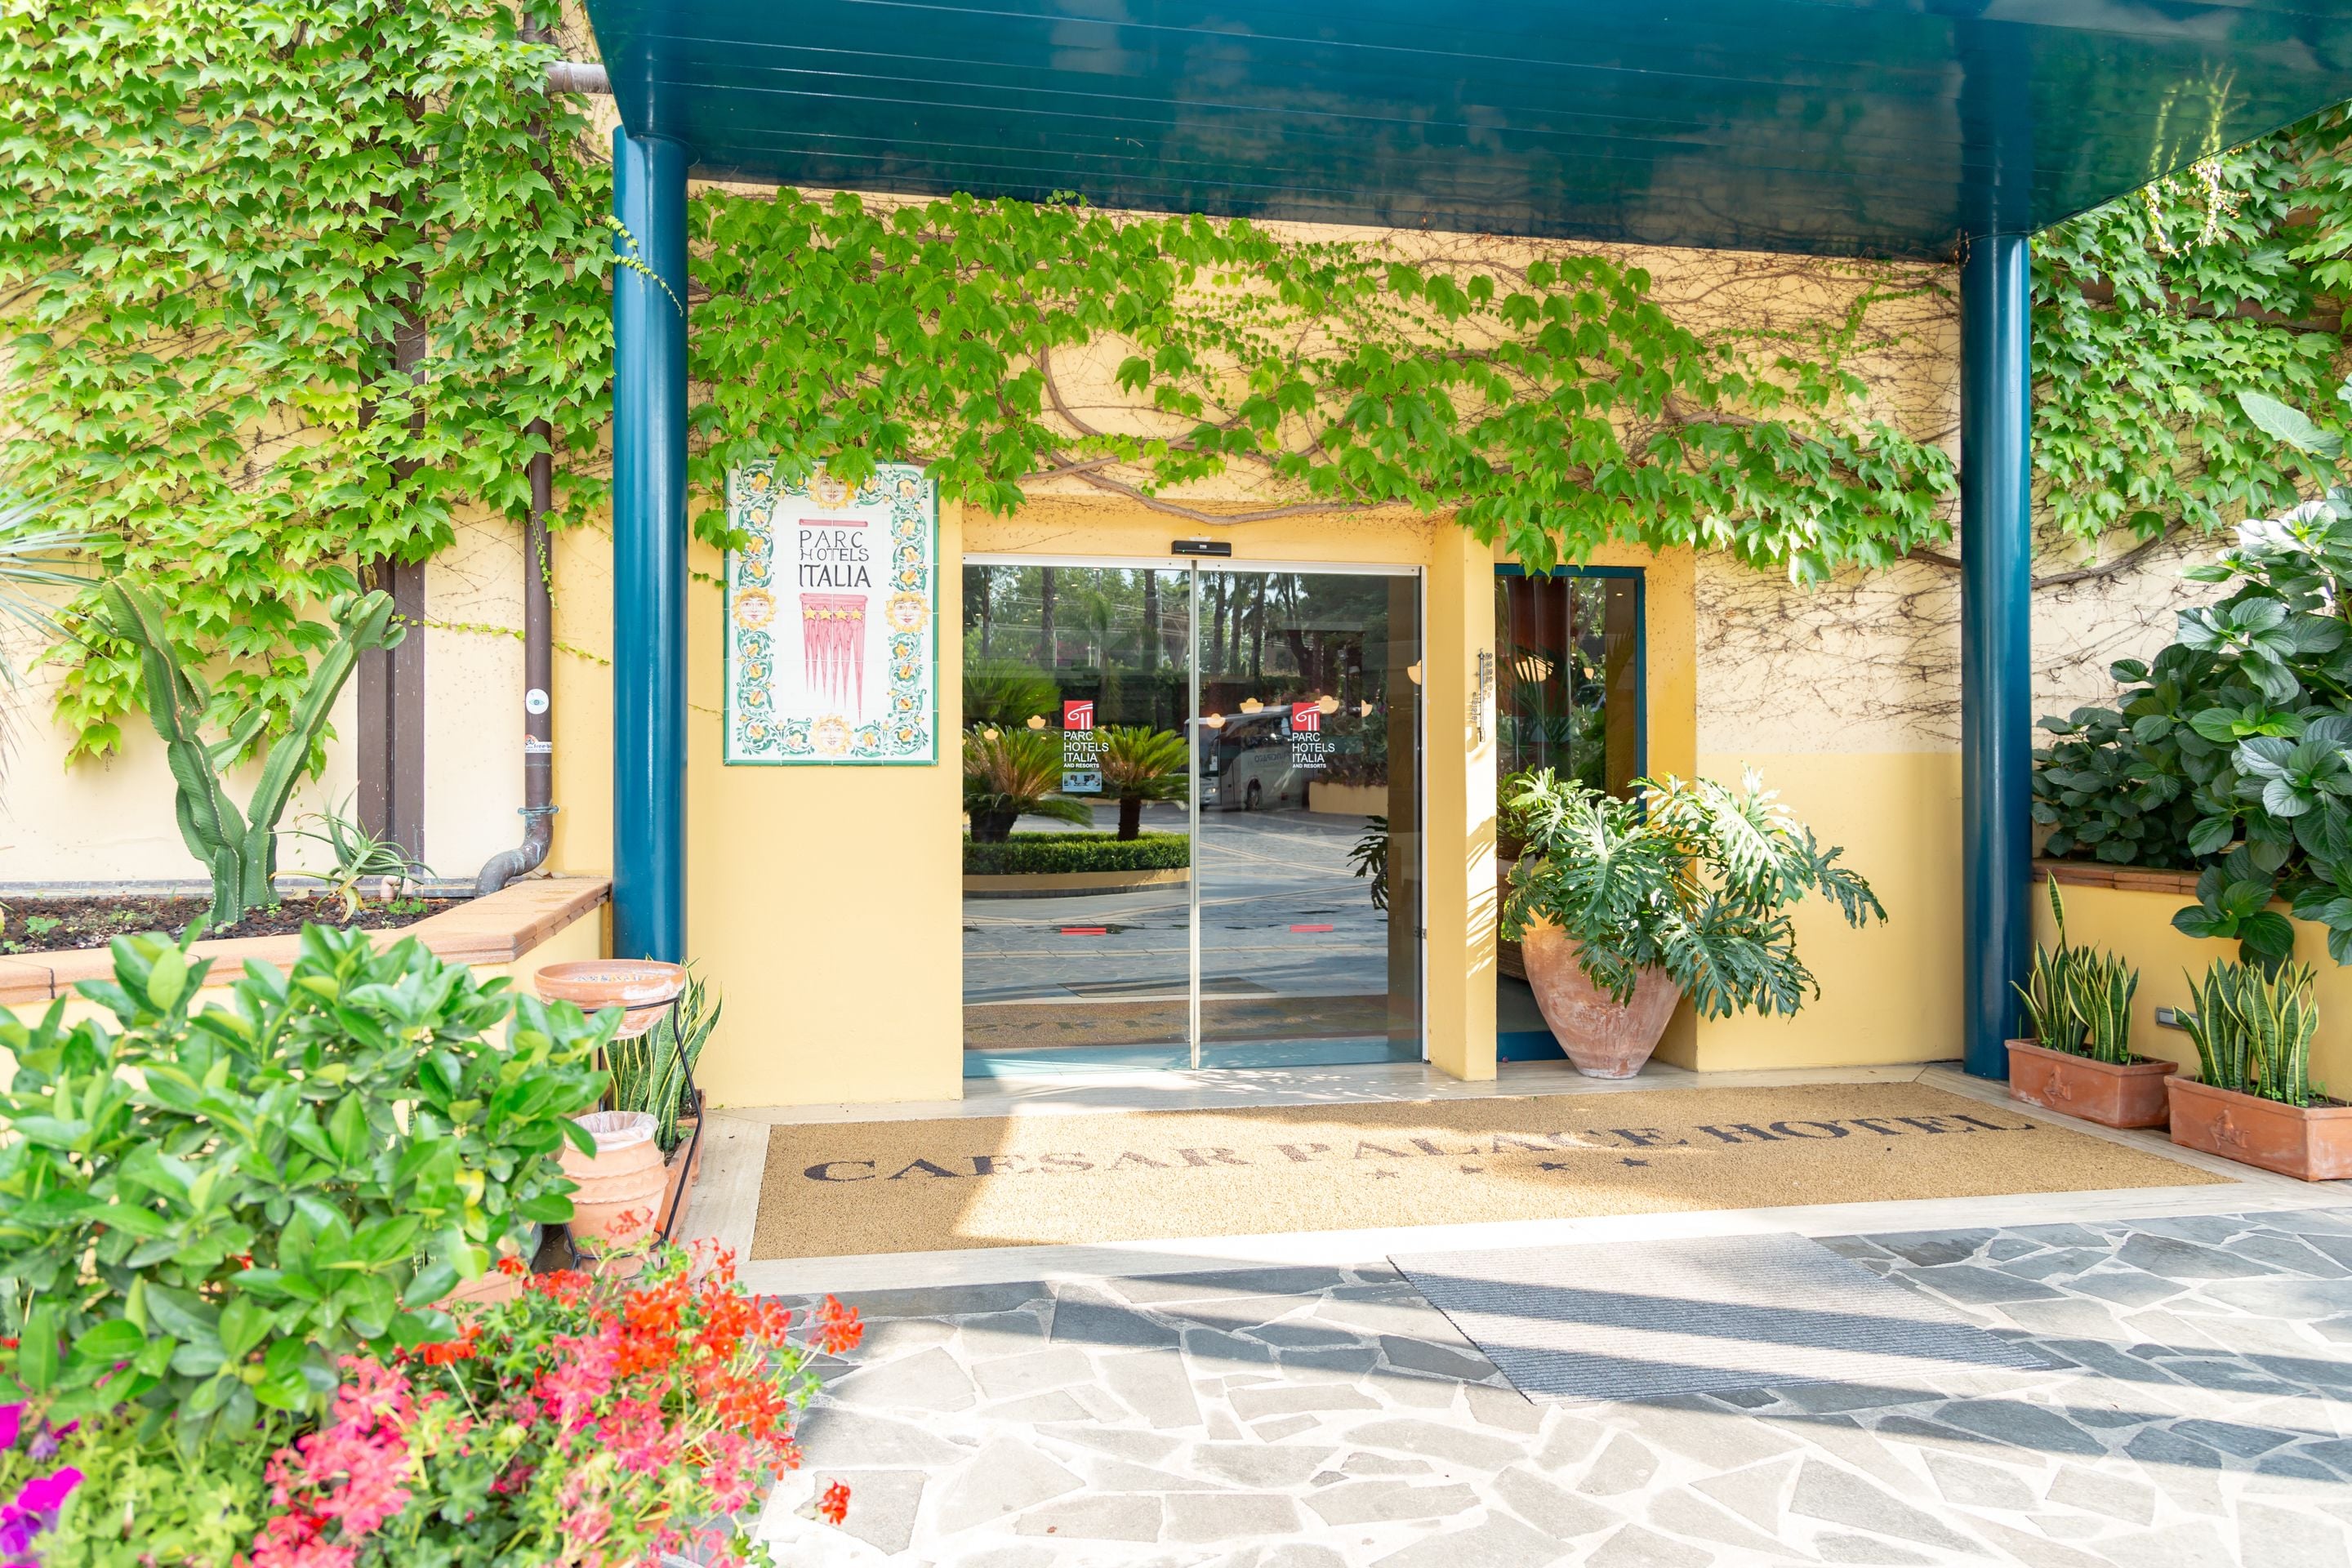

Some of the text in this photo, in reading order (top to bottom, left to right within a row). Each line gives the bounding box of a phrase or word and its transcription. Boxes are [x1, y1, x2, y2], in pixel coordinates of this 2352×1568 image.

[799, 529, 863, 548] PARC
[800, 548, 870, 562] HOTELS
[799, 564, 872, 588] ITALIA
[1063, 732, 1094, 741] PARC
[1292, 733, 1321, 742] PARC
[1063, 742, 1109, 751] HOTELS
[1292, 743, 1335, 752] HOTELS
[1063, 752, 1098, 762] ITALIA
[1292, 753, 1325, 763] ITALIA
[804, 1114, 2037, 1183] CAESAR PALACE HOTEL
